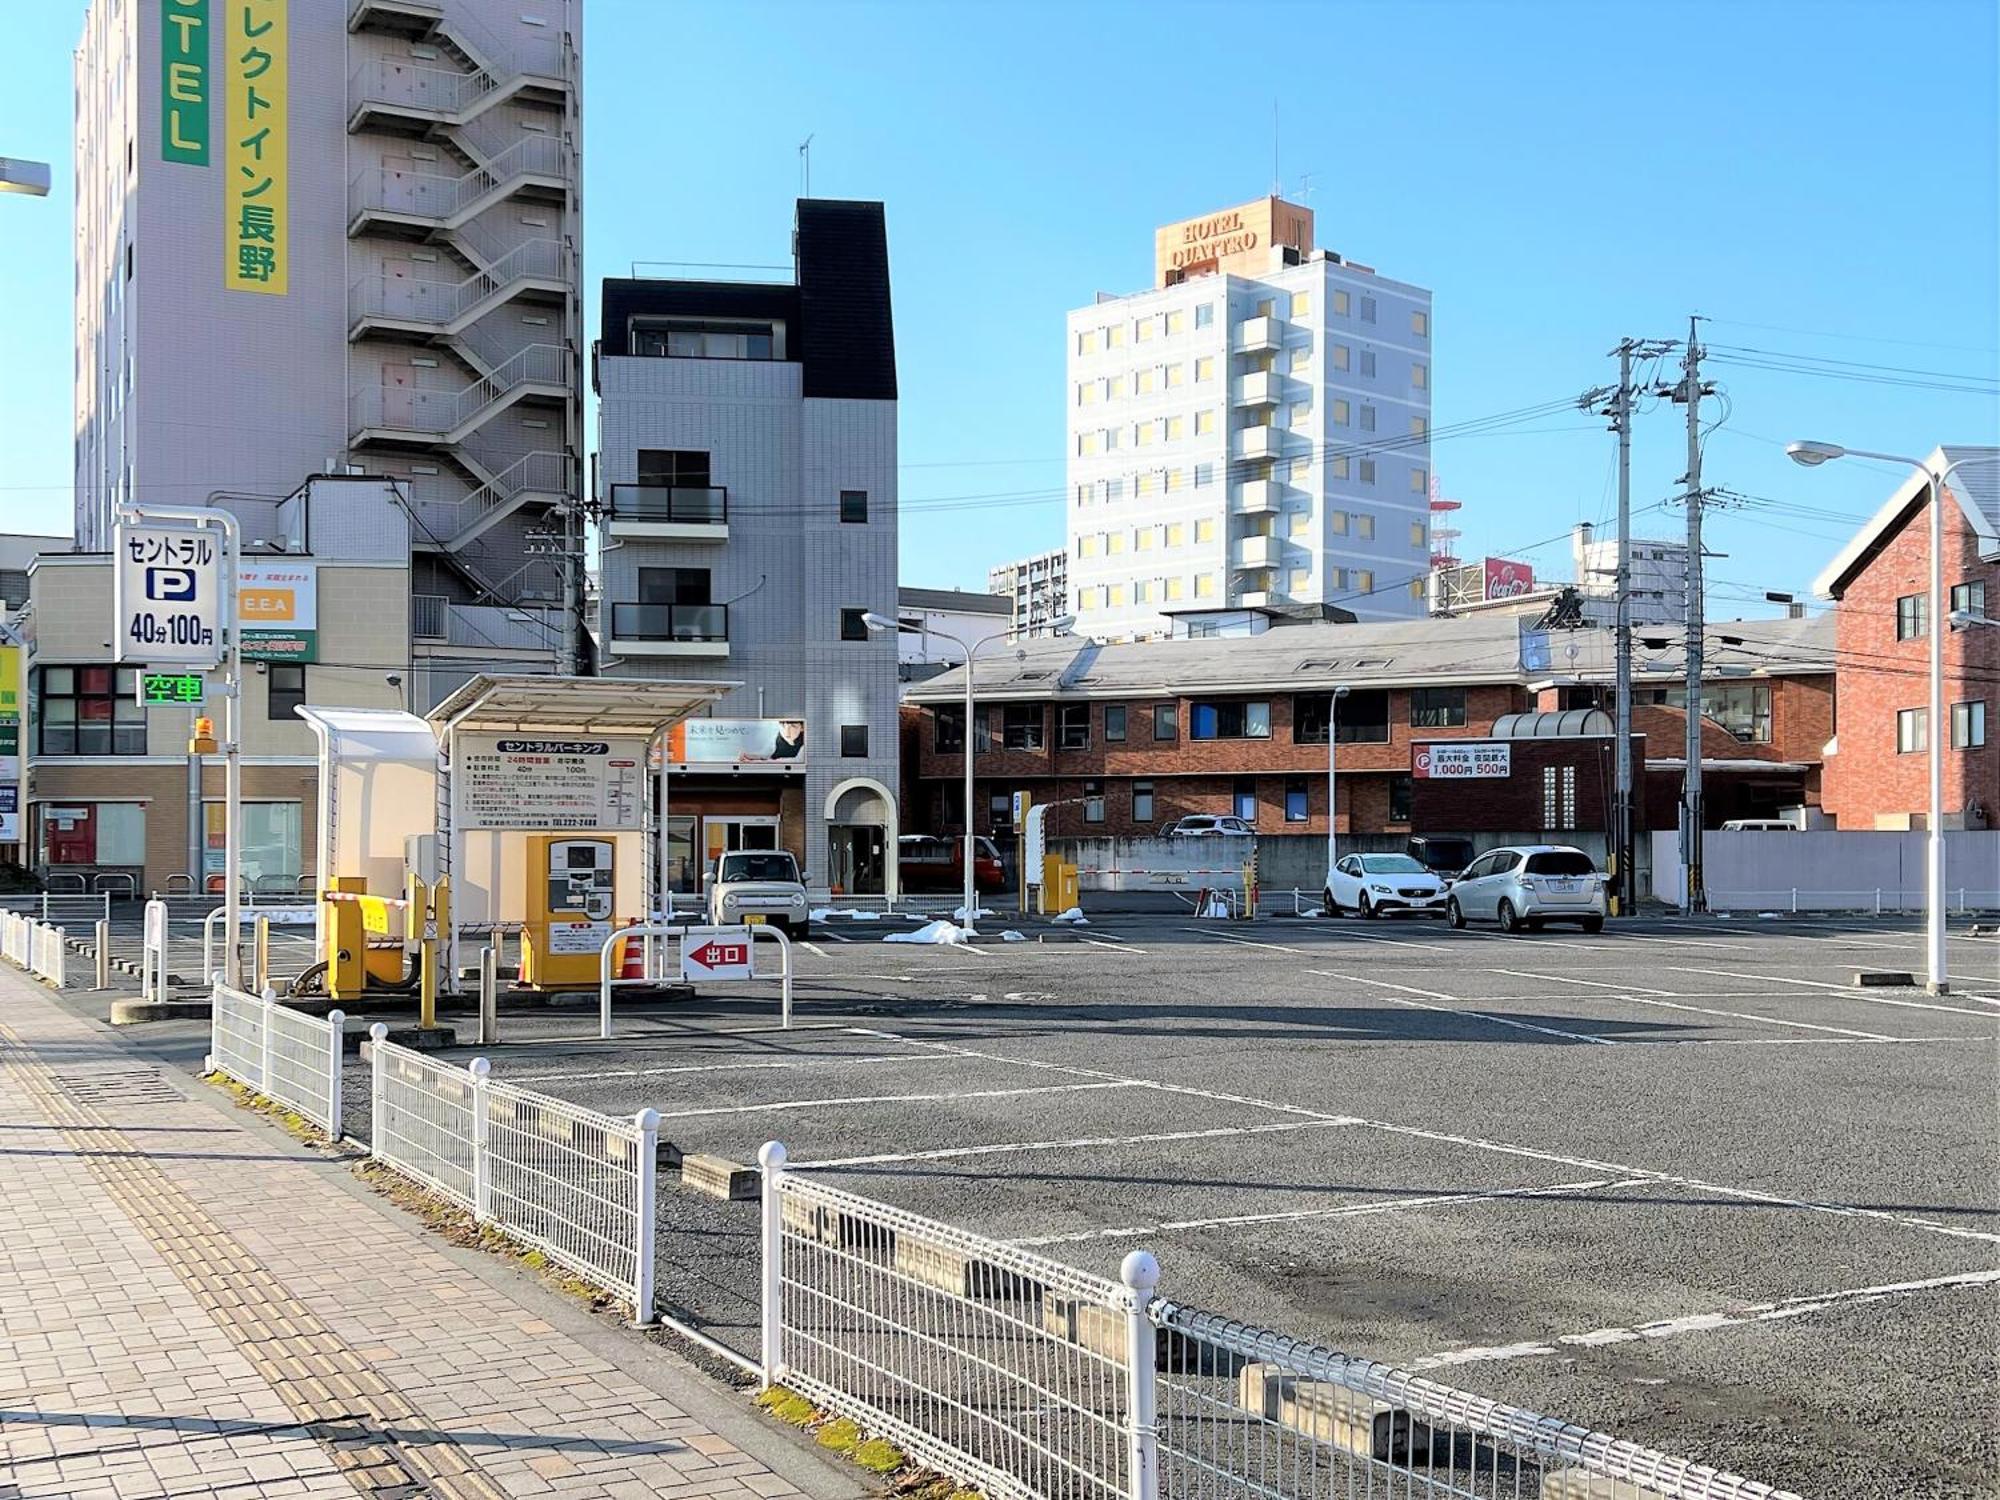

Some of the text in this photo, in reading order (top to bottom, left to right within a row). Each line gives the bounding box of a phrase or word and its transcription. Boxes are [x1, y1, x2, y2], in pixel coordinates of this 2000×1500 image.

[169, 0, 202, 149] TEL
[238, 0, 275, 281] レクトイン長野
[1184, 213, 1244, 244] HOTEL
[1172, 232, 1257, 267] QUATTRO
[129, 537, 212, 566] セントラル
[153, 569, 191, 600] P
[144, 674, 203, 703] 空車
[1476, 763, 1508, 775] 500円
[706, 946, 739, 963] 出口
